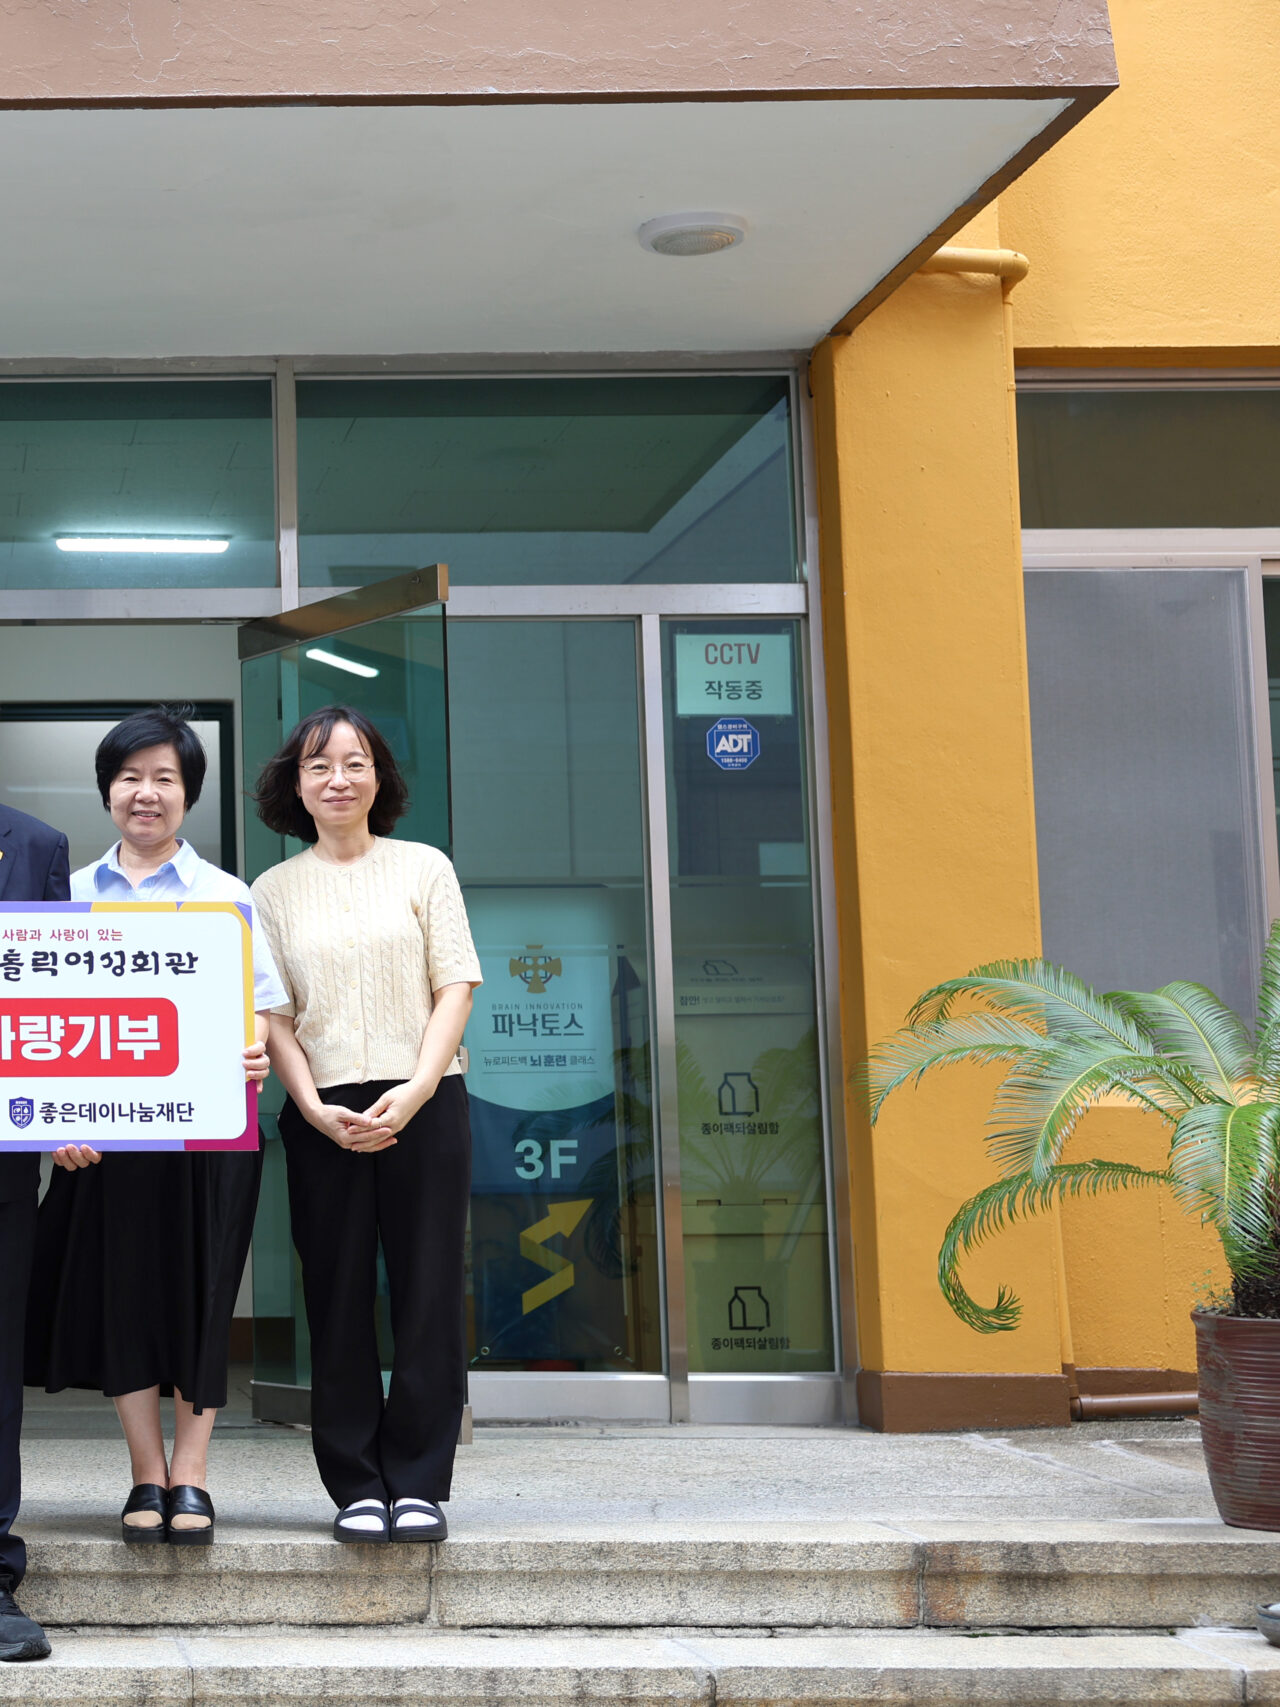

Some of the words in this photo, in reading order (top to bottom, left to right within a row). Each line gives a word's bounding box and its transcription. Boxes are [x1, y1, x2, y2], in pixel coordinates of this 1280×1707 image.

[704, 642, 761, 665] CCTV
[705, 680, 763, 700] 작동중
[715, 734, 752, 753] ADT
[2, 929, 42, 942] 사람과
[50, 928, 90, 942] 사랑이
[97, 928, 123, 942] 있는
[491, 1003, 521, 1011] BRAIN
[525, 1002, 584, 1011] INNOVATION
[491, 1012, 585, 1038] 파낙토스
[483, 1055, 528, 1066] 뉴로피드백
[570, 1055, 596, 1066] 클래스
[38, 1101, 196, 1124] 좋은데이나눔재단
[514, 1138, 579, 1180] 3F
